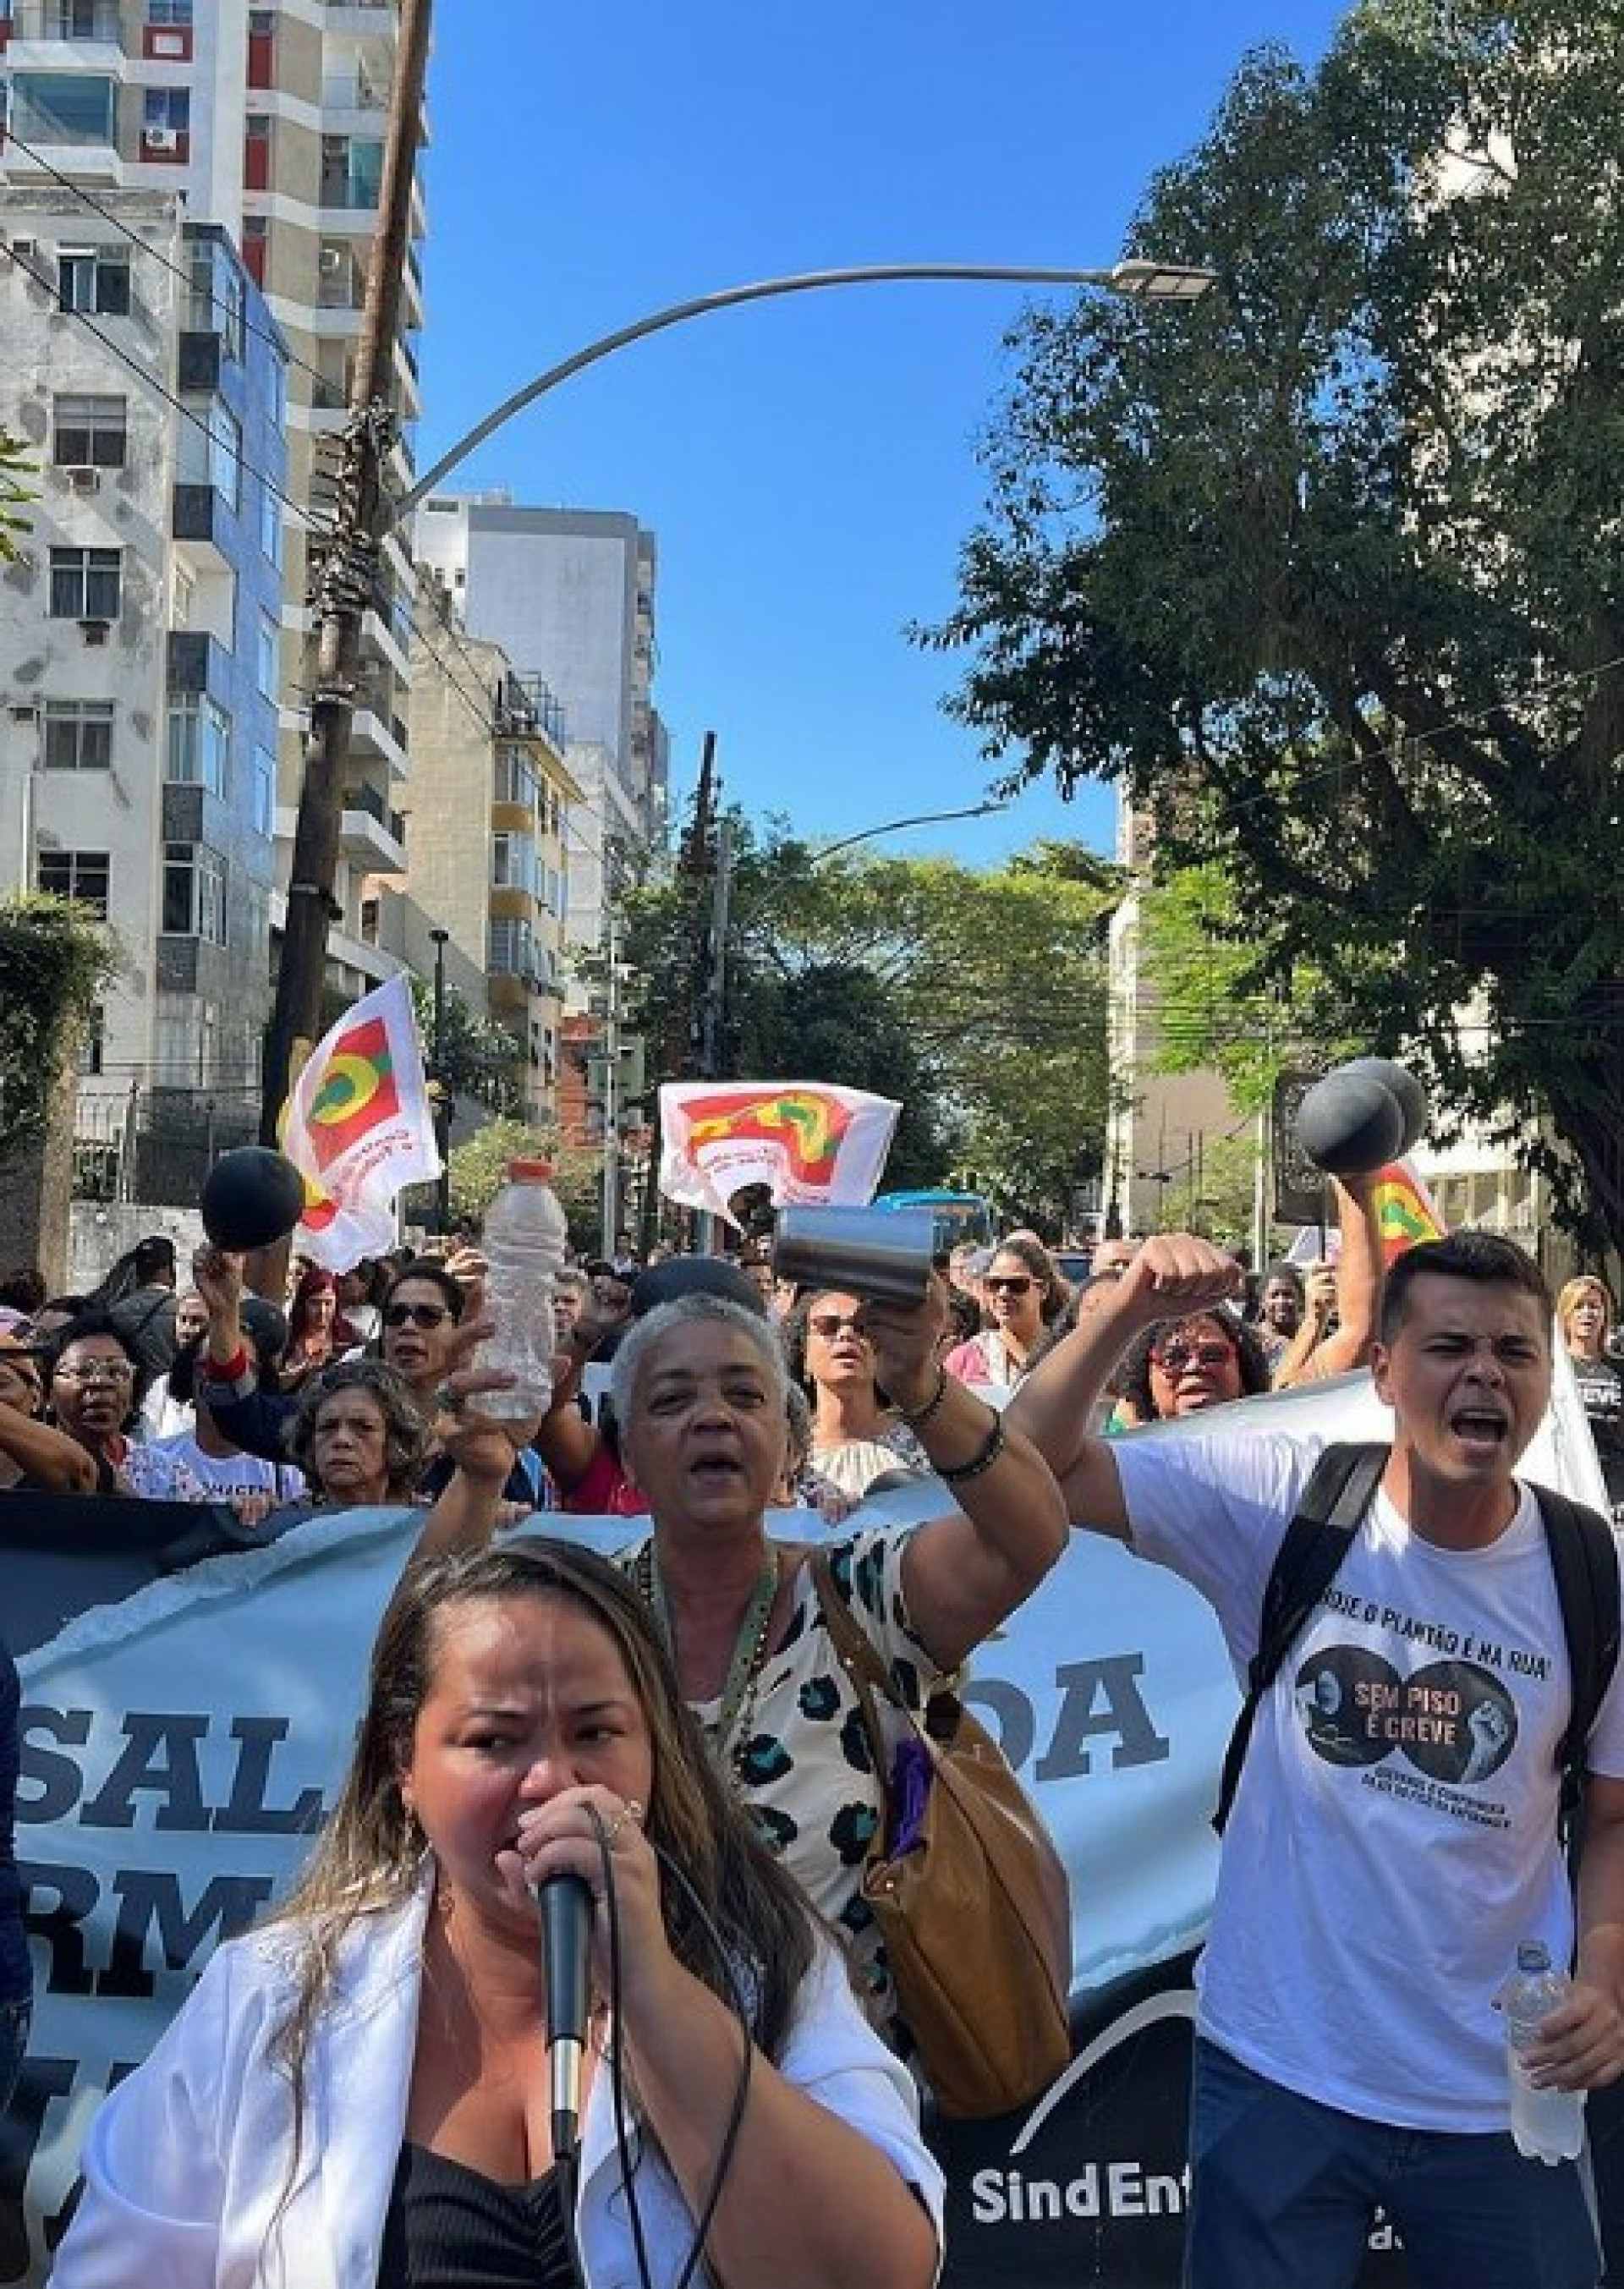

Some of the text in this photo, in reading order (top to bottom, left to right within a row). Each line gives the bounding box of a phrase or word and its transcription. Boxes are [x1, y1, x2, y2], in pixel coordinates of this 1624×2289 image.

[1365, 1605, 1378, 1625] O
[1478, 1640, 1502, 1668] NA
[1355, 1681, 1460, 1715] SEM PISO
[1385, 1717, 1456, 1745] GREVE
